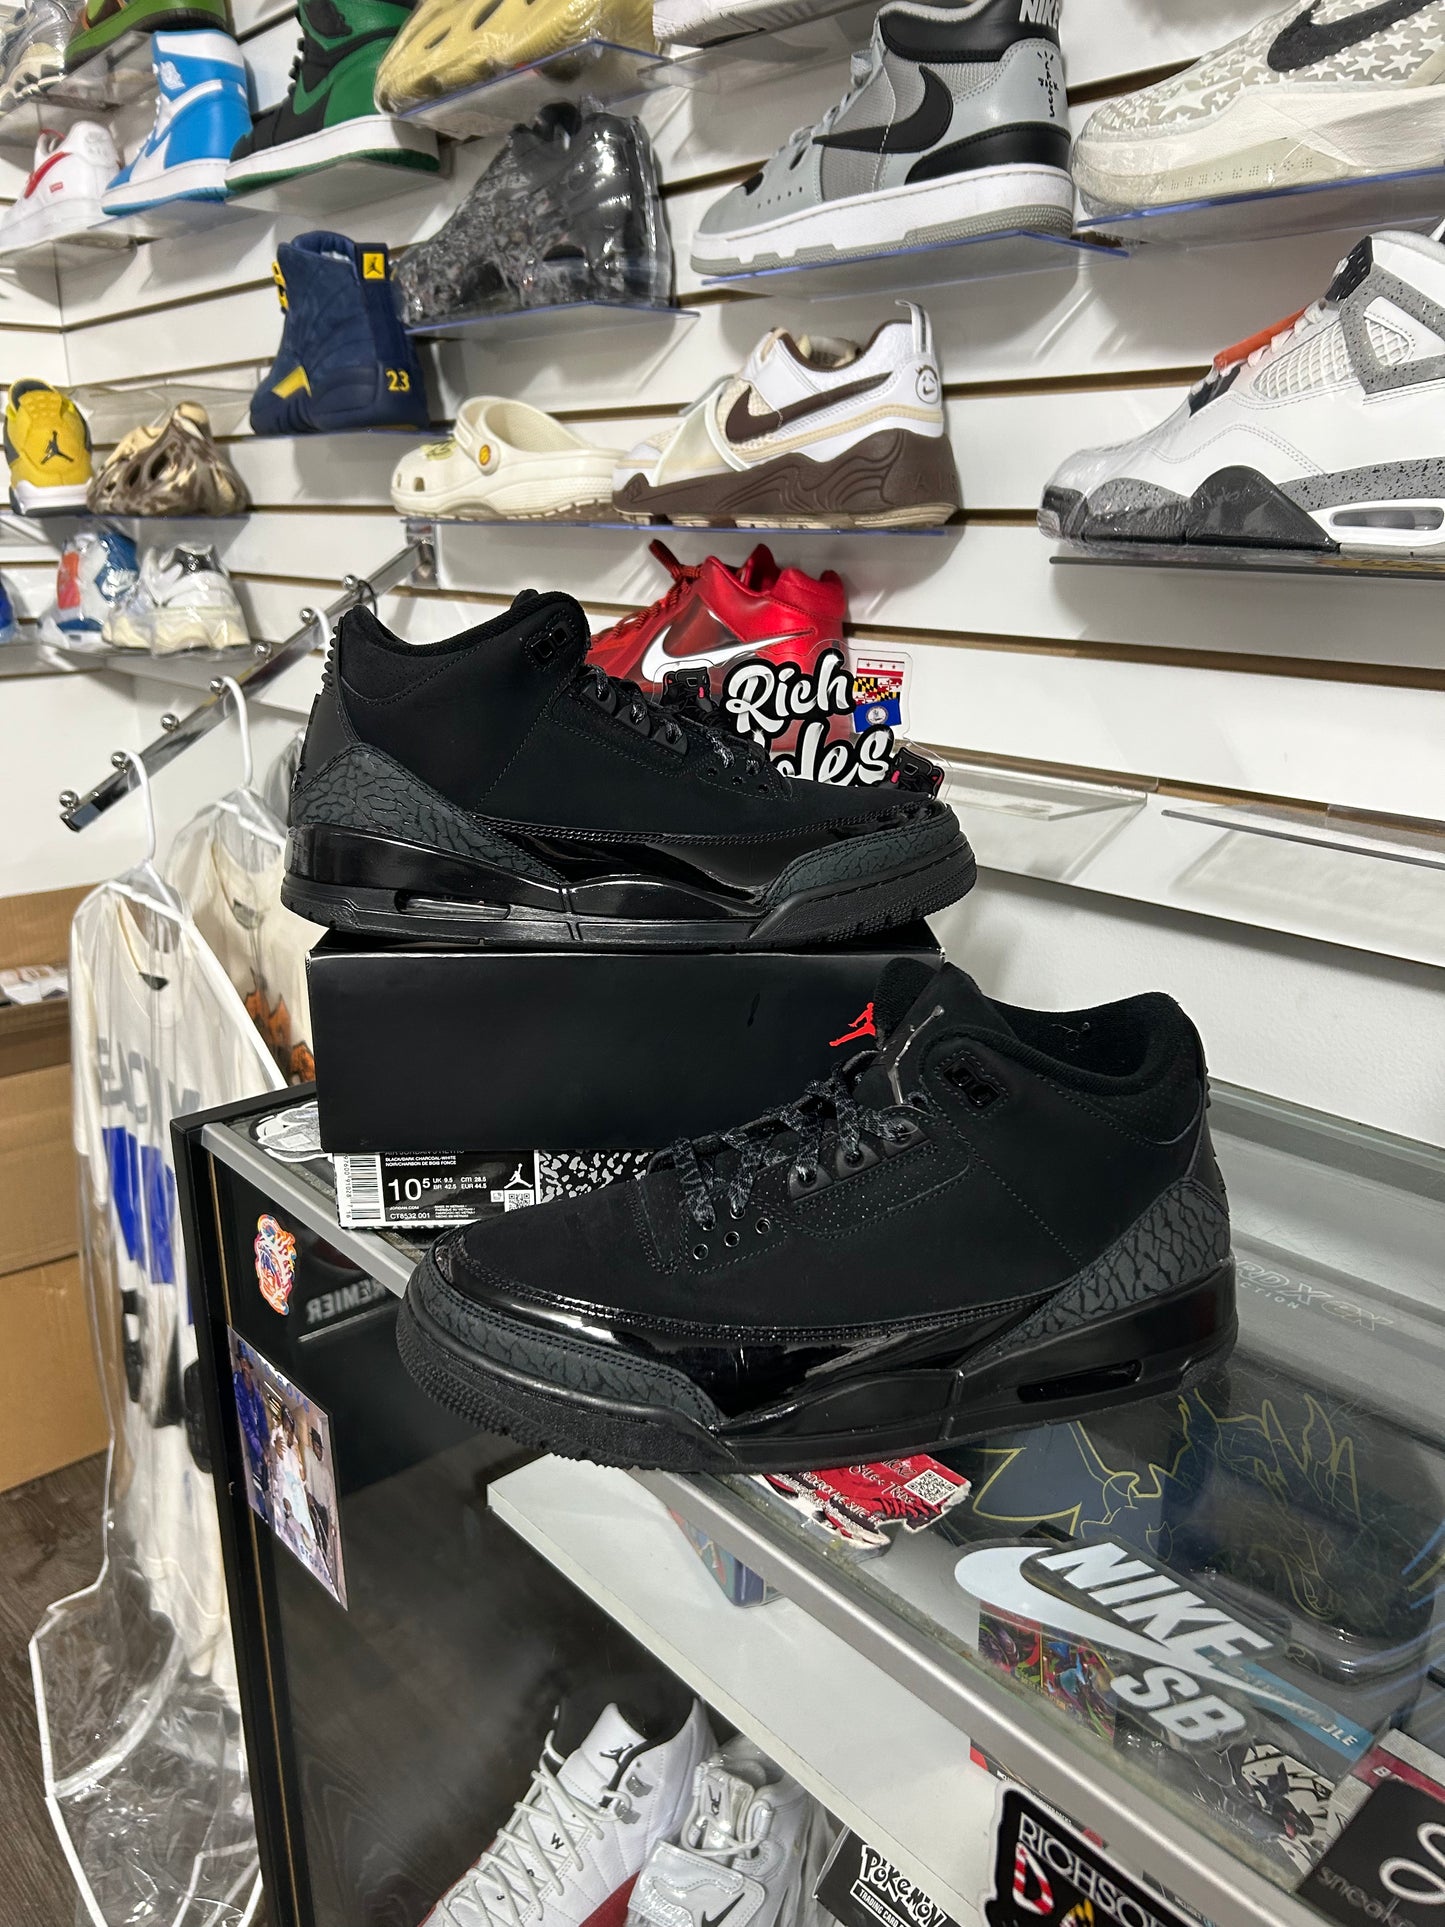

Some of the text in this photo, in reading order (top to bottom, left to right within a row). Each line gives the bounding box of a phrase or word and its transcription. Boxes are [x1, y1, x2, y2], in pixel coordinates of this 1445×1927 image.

[385, 369, 411, 393] 23
[725, 652, 850, 733] Rich
[417, 1212, 431, 1220] 001
[1037, 1541, 1275, 1658] NIKE
[1110, 1665, 1248, 1743] SB
[859, 1887, 885, 1914] TRADING
